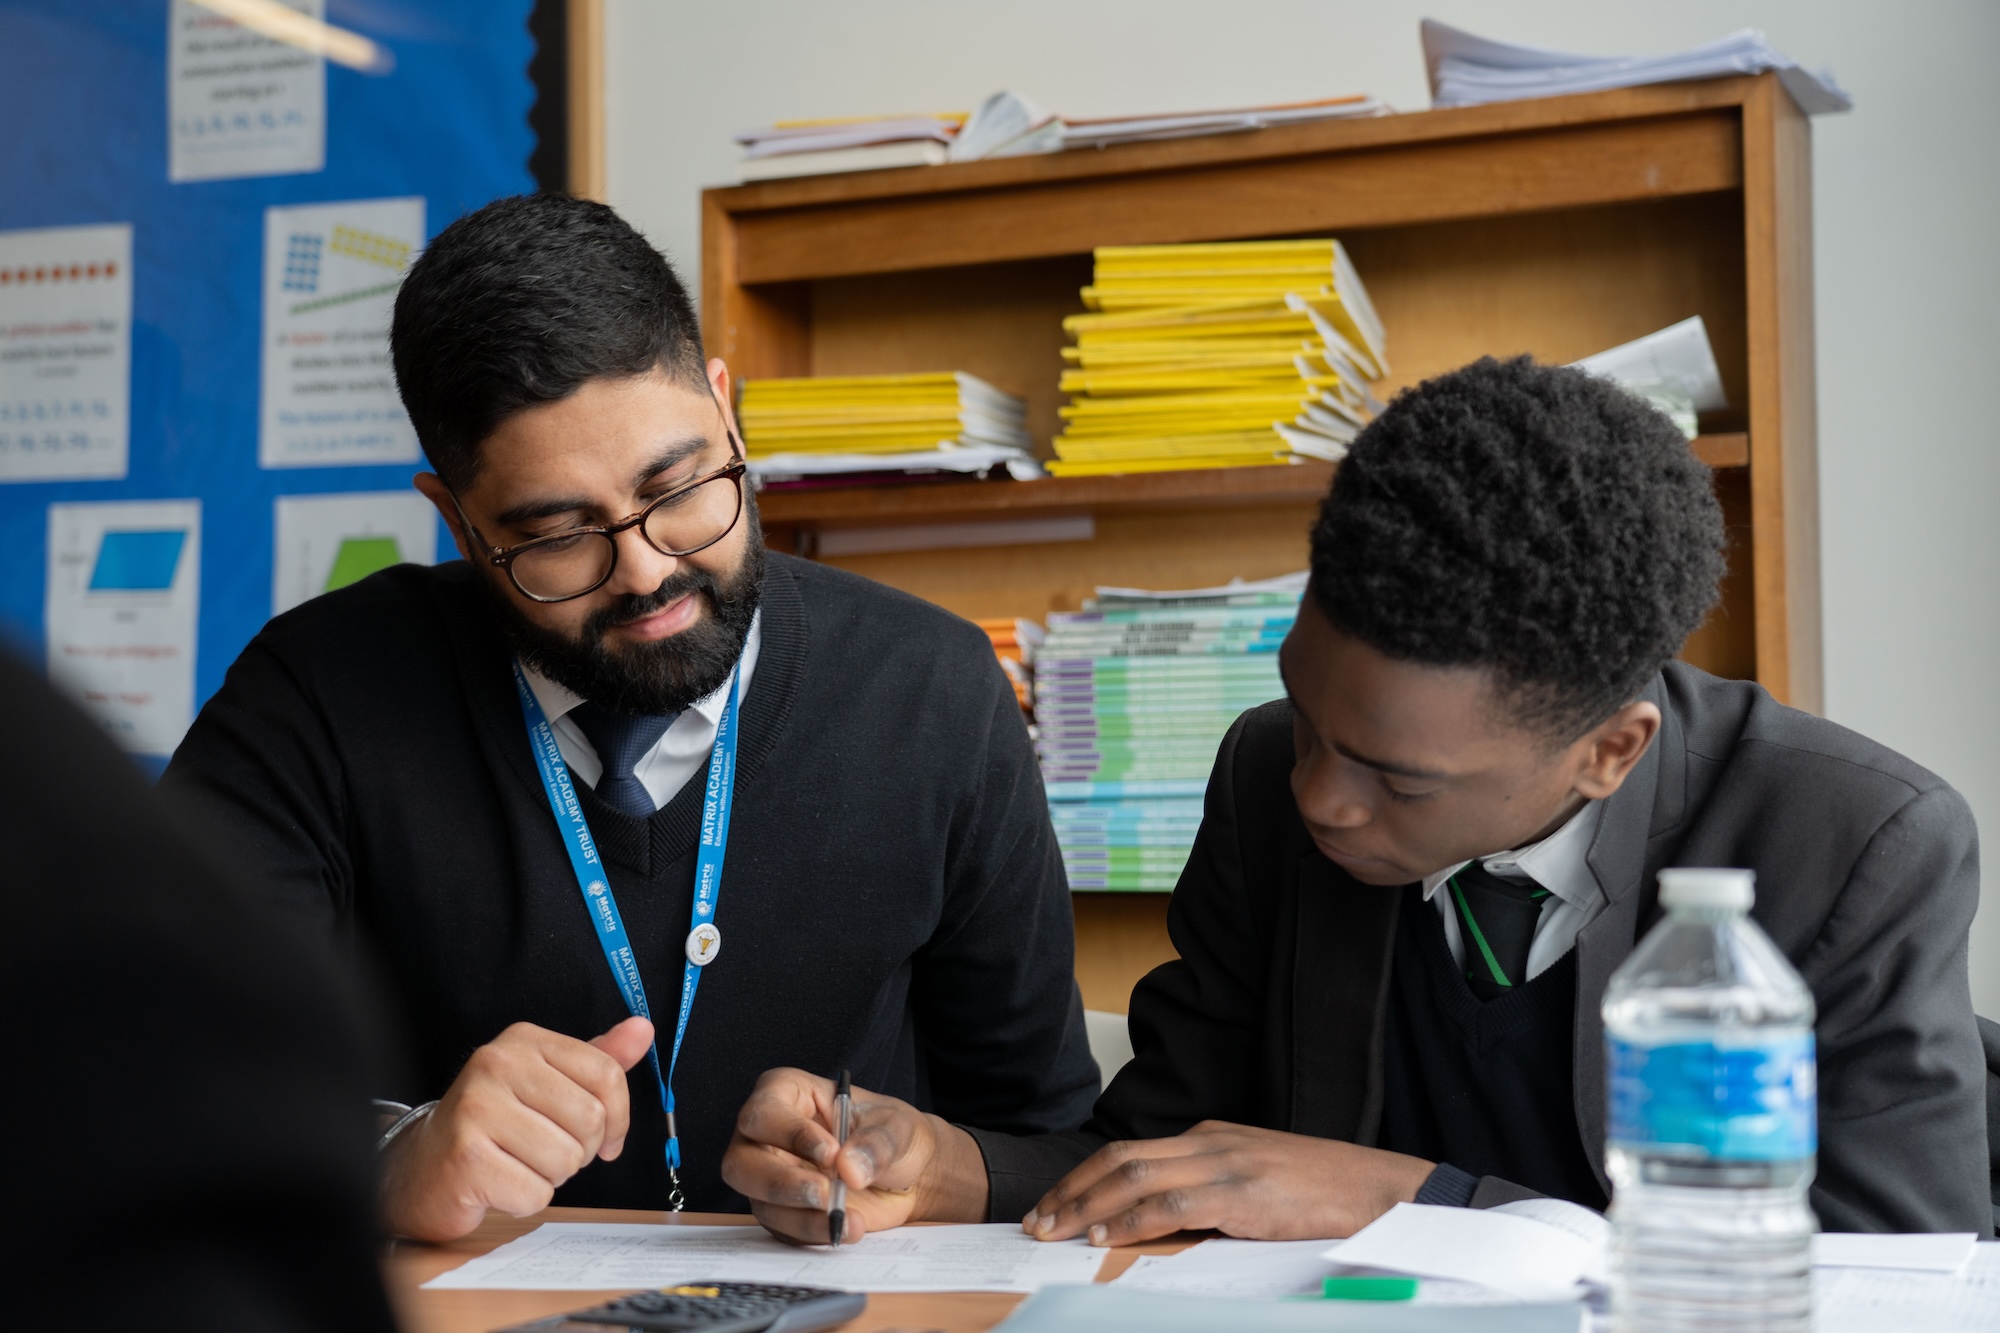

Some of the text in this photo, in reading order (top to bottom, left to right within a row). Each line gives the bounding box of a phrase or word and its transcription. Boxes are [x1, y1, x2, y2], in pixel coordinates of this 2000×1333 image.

[531, 726, 566, 817] Education without Exception
[538, 721, 599, 865] MATRIX ACADEMY TRUST
[702, 702, 731, 846] MATRIX ACADEMY TRUST
[714, 752, 731, 847] Education without Exception
[599, 896, 617, 931] Matrix
[699, 863, 712, 899] Matrix
[610, 950, 627, 984] Education
[624, 984, 637, 1009] without
[619, 946, 640, 992] MATRIX
